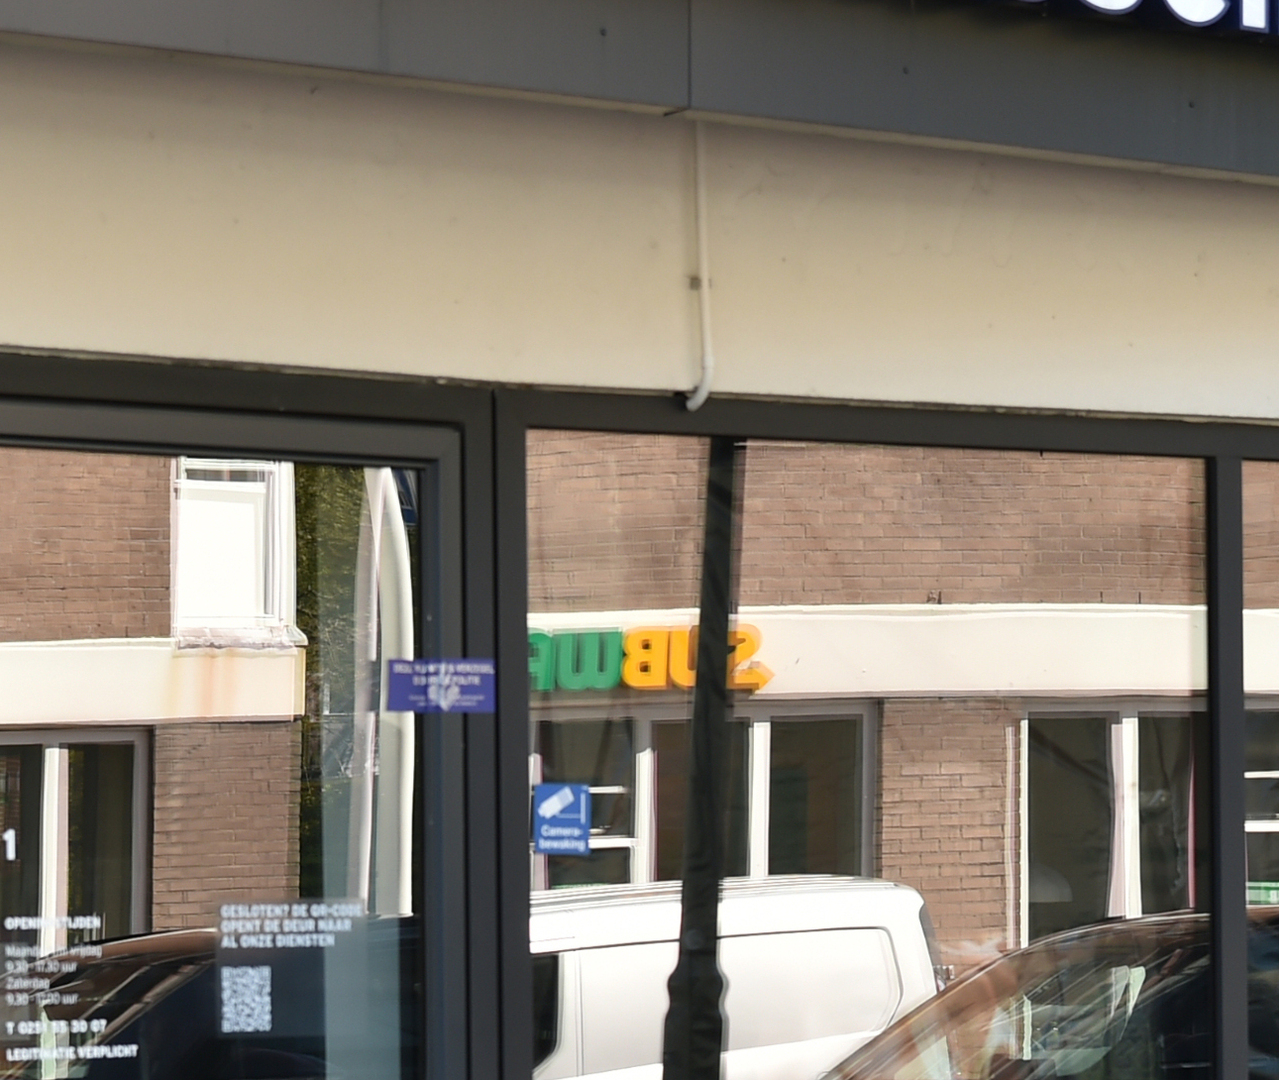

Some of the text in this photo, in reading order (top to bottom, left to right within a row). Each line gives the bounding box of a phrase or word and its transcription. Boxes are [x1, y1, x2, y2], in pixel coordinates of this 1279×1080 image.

[2, 828, 16, 861] 1
[538, 838, 586, 852] bewaking
[221, 904, 290, 918] GESLOTEN?
[291, 904, 308, 917] DE
[4, 916, 101, 930] OPENISTIJDEN
[221, 918, 352, 932] OPENT DE DEUR NAAR
[221, 933, 335, 948] AL ONZE DIENSTEN
[5, 945, 46, 957] Maand
[77, 1044, 138, 1059] VERPLICHT
